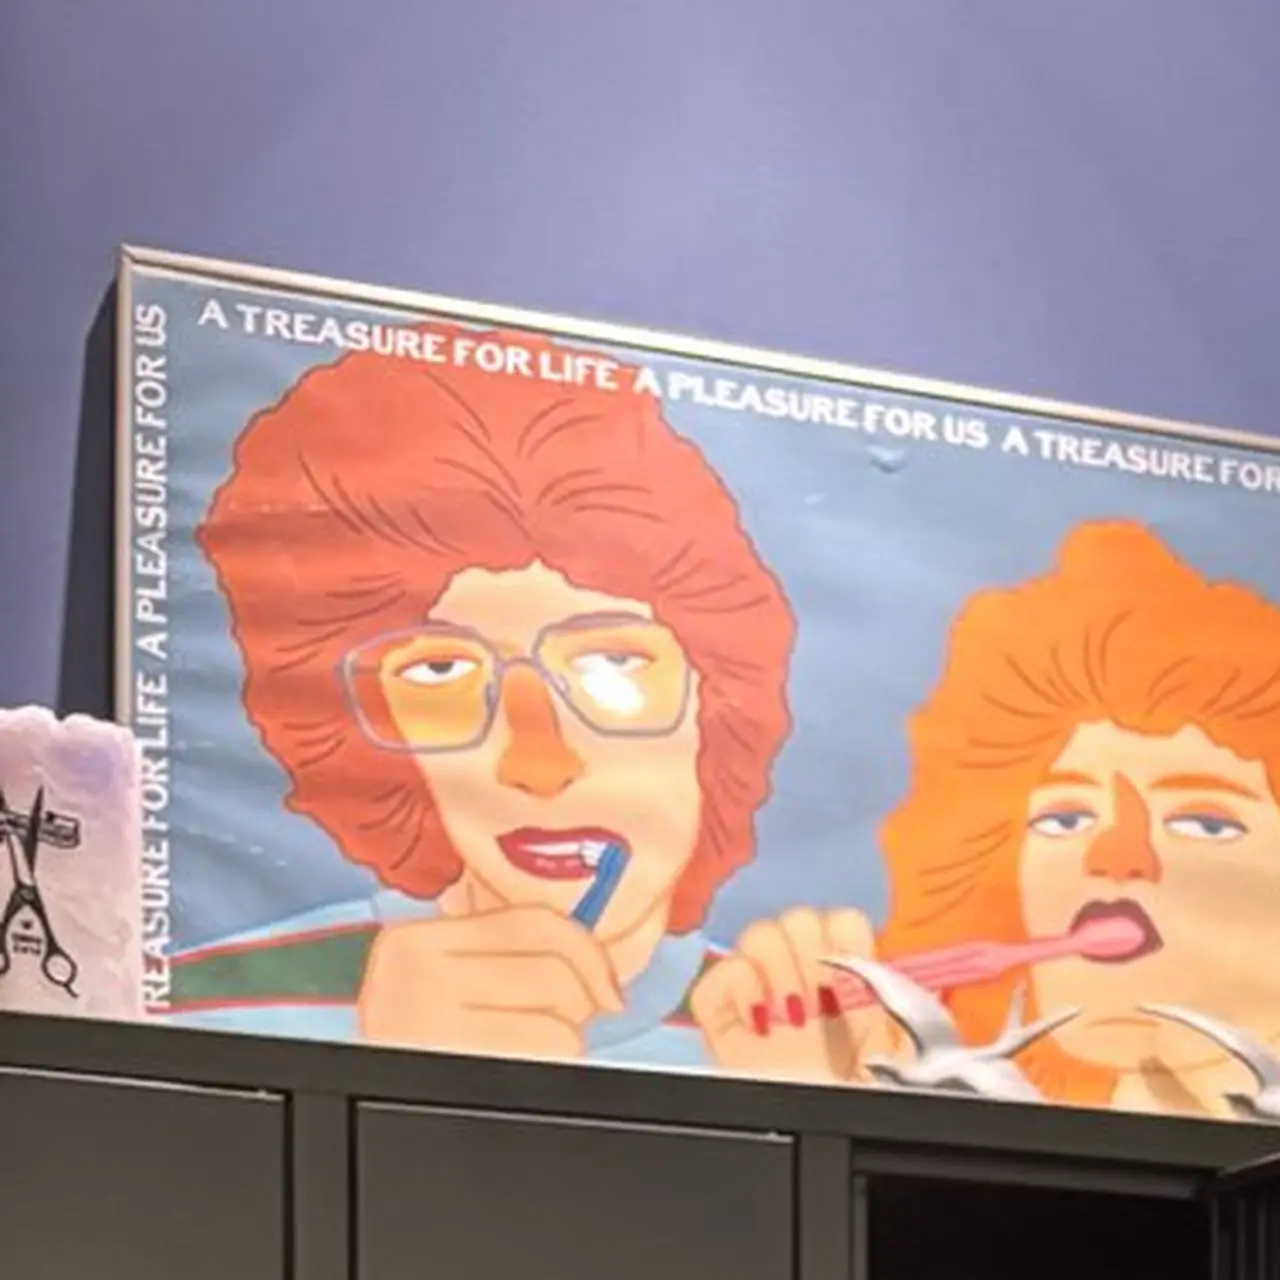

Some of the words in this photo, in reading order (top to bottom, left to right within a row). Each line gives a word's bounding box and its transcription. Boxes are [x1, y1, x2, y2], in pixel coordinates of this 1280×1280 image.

[134, 304, 167, 346] US
[135, 354, 167, 429] FOR
[197, 299, 229, 329] A
[236, 303, 447, 363] TREASURE
[453, 338, 533, 377] FOR
[538, 351, 619, 390] LIFE
[632, 366, 663, 398] A
[668, 371, 860, 429] PLEASURE
[863, 403, 937, 441] FOR
[943, 415, 990, 449] US
[1001, 425, 1030, 456] A
[1033, 430, 1214, 484] TREASURE
[135, 434, 168, 624] PLEASURE
[136, 632, 168, 660] A
[136, 671, 168, 748] LIFE
[141, 840, 170, 1009] REASURE
